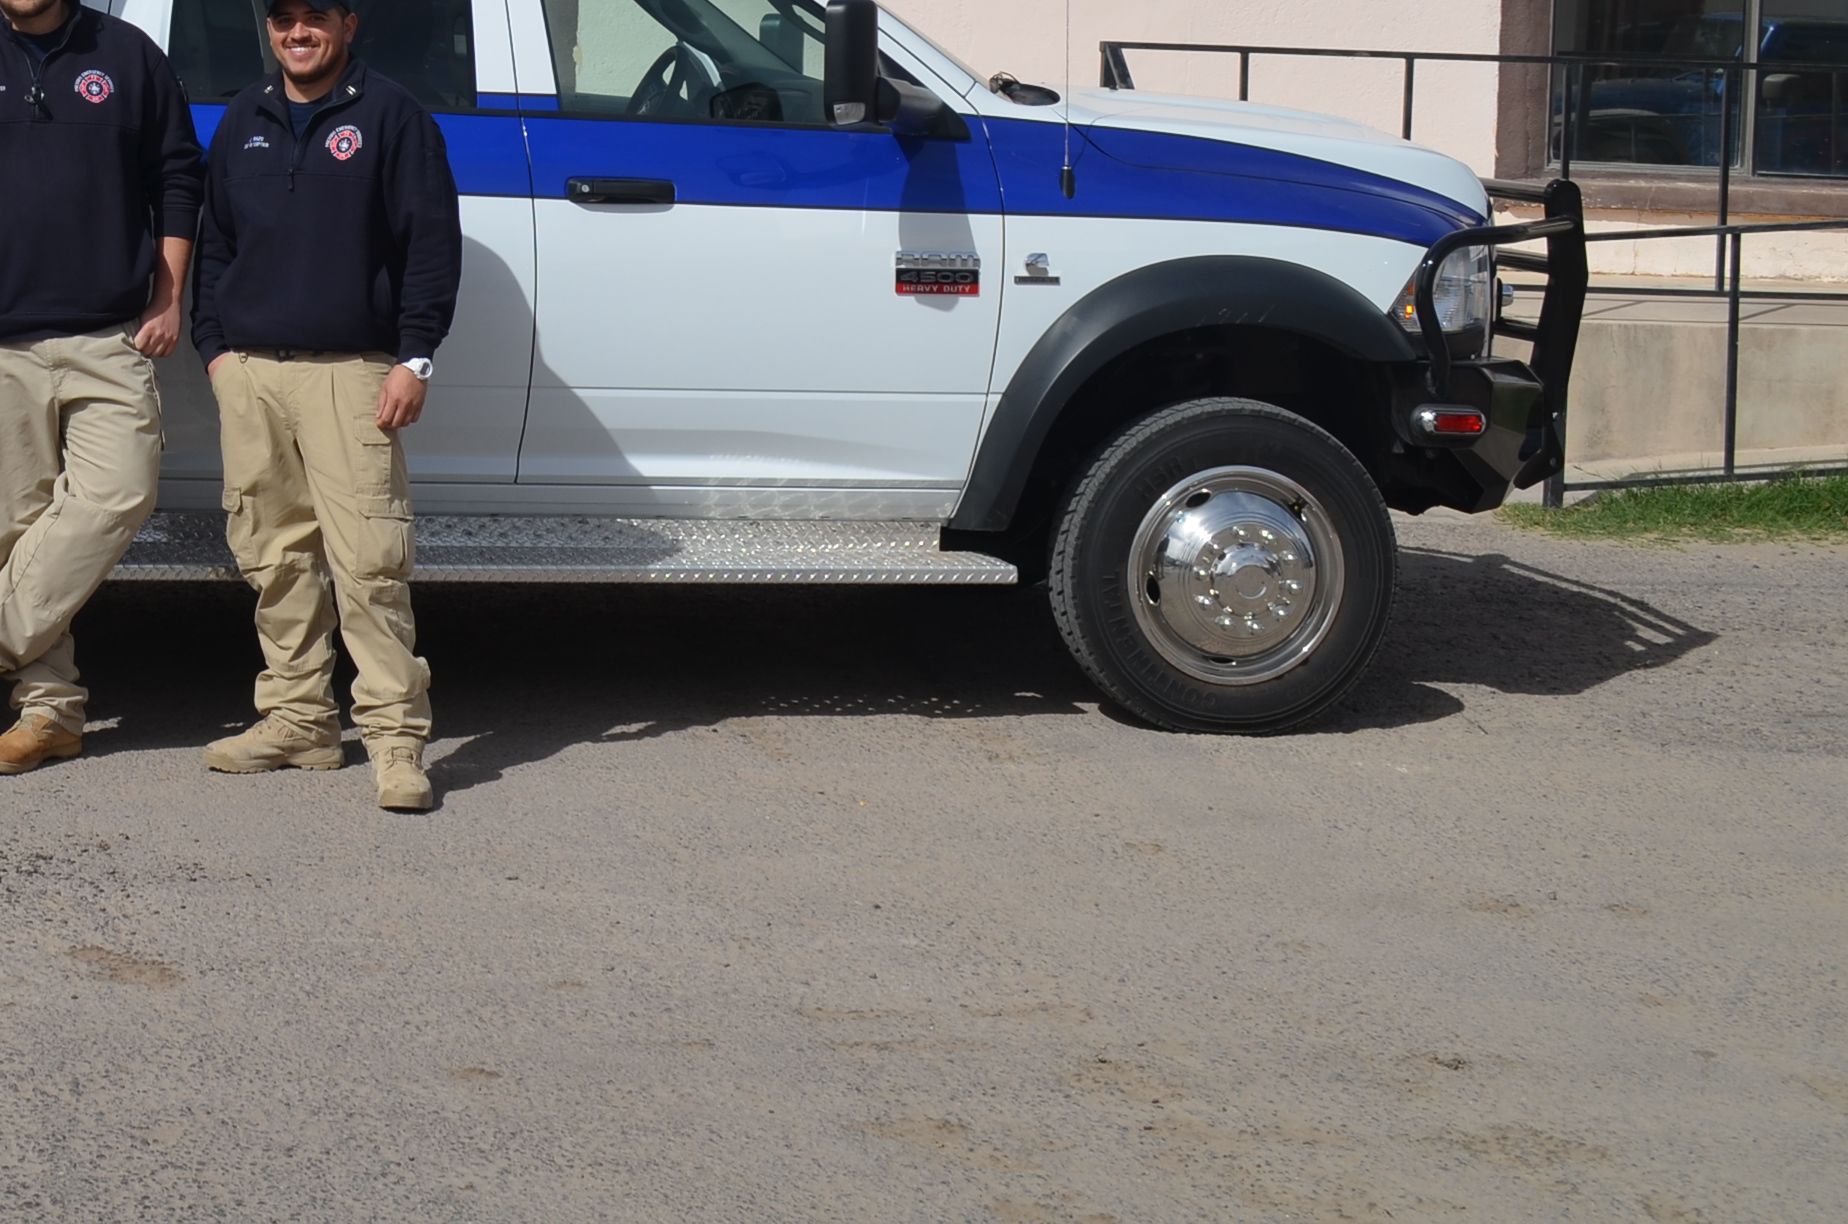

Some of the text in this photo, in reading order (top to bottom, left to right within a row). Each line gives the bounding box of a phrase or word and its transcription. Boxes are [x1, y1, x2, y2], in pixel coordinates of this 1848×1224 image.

[900, 271, 973, 283] 4500
[902, 284, 971, 293] HEAVY DUTY
